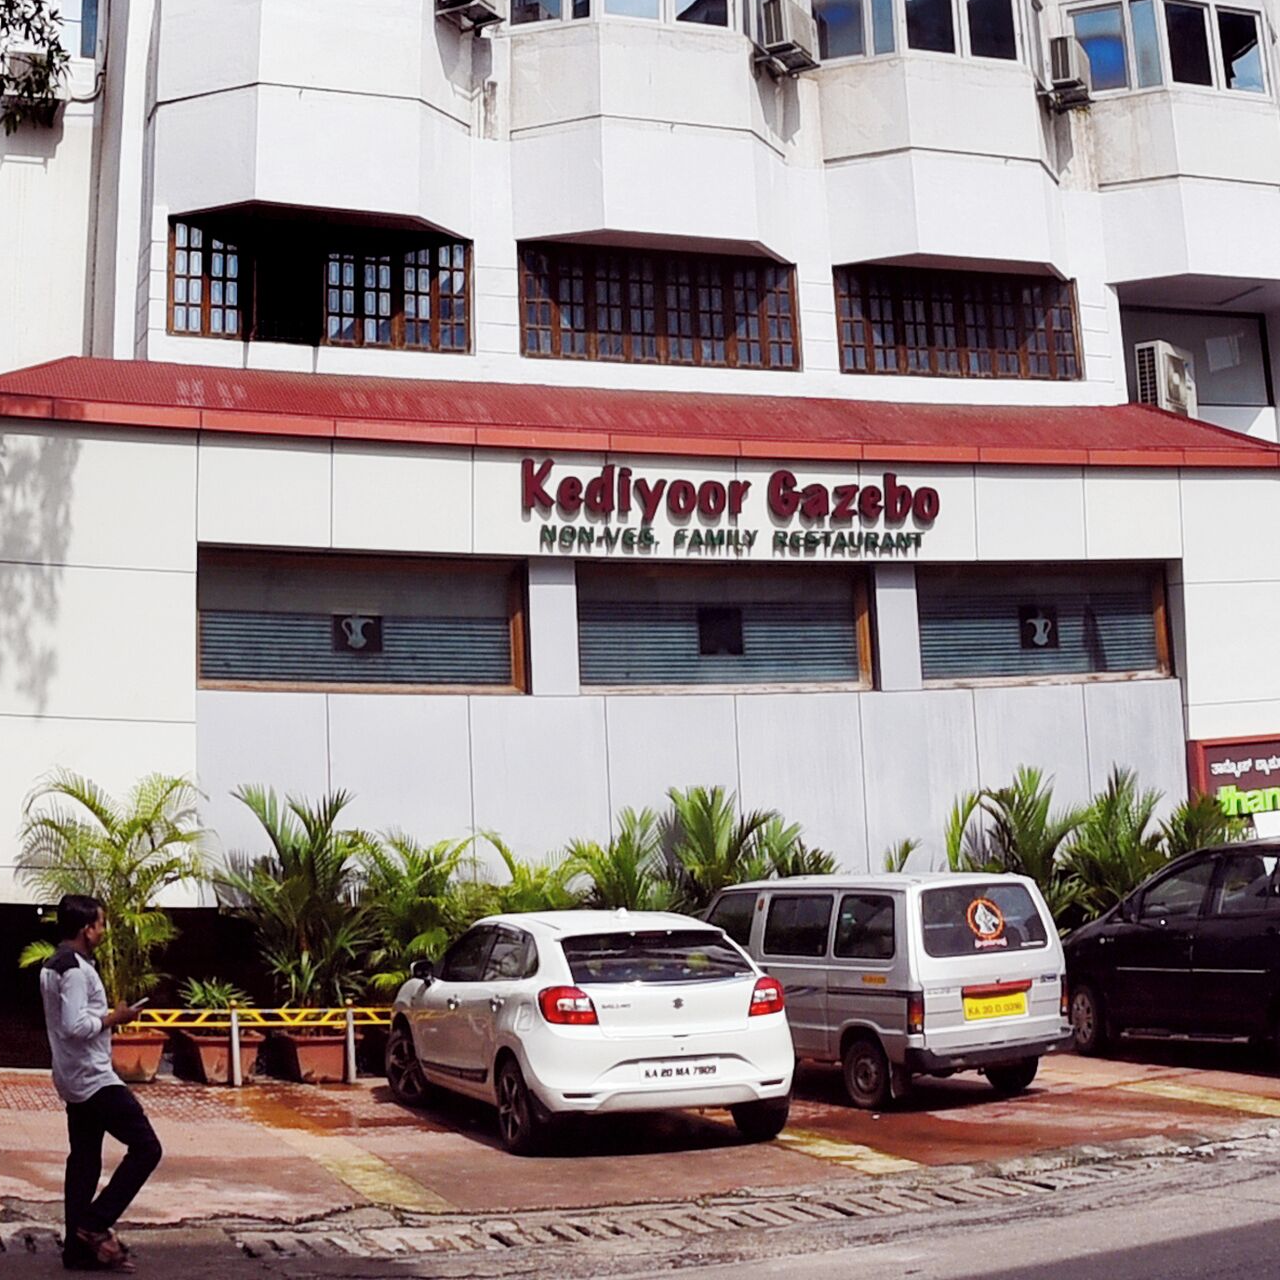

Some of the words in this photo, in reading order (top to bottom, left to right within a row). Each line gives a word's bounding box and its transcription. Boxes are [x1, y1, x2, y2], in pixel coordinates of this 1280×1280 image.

[521, 458, 751, 521] Kediyoor
[767, 470, 940, 520] Gazebo
[675, 528, 758, 550] FAMILY
[774, 531, 925, 551] RESTAURANT
[644, 1069, 658, 1079] KA
[675, 1067, 690, 1076] MA
